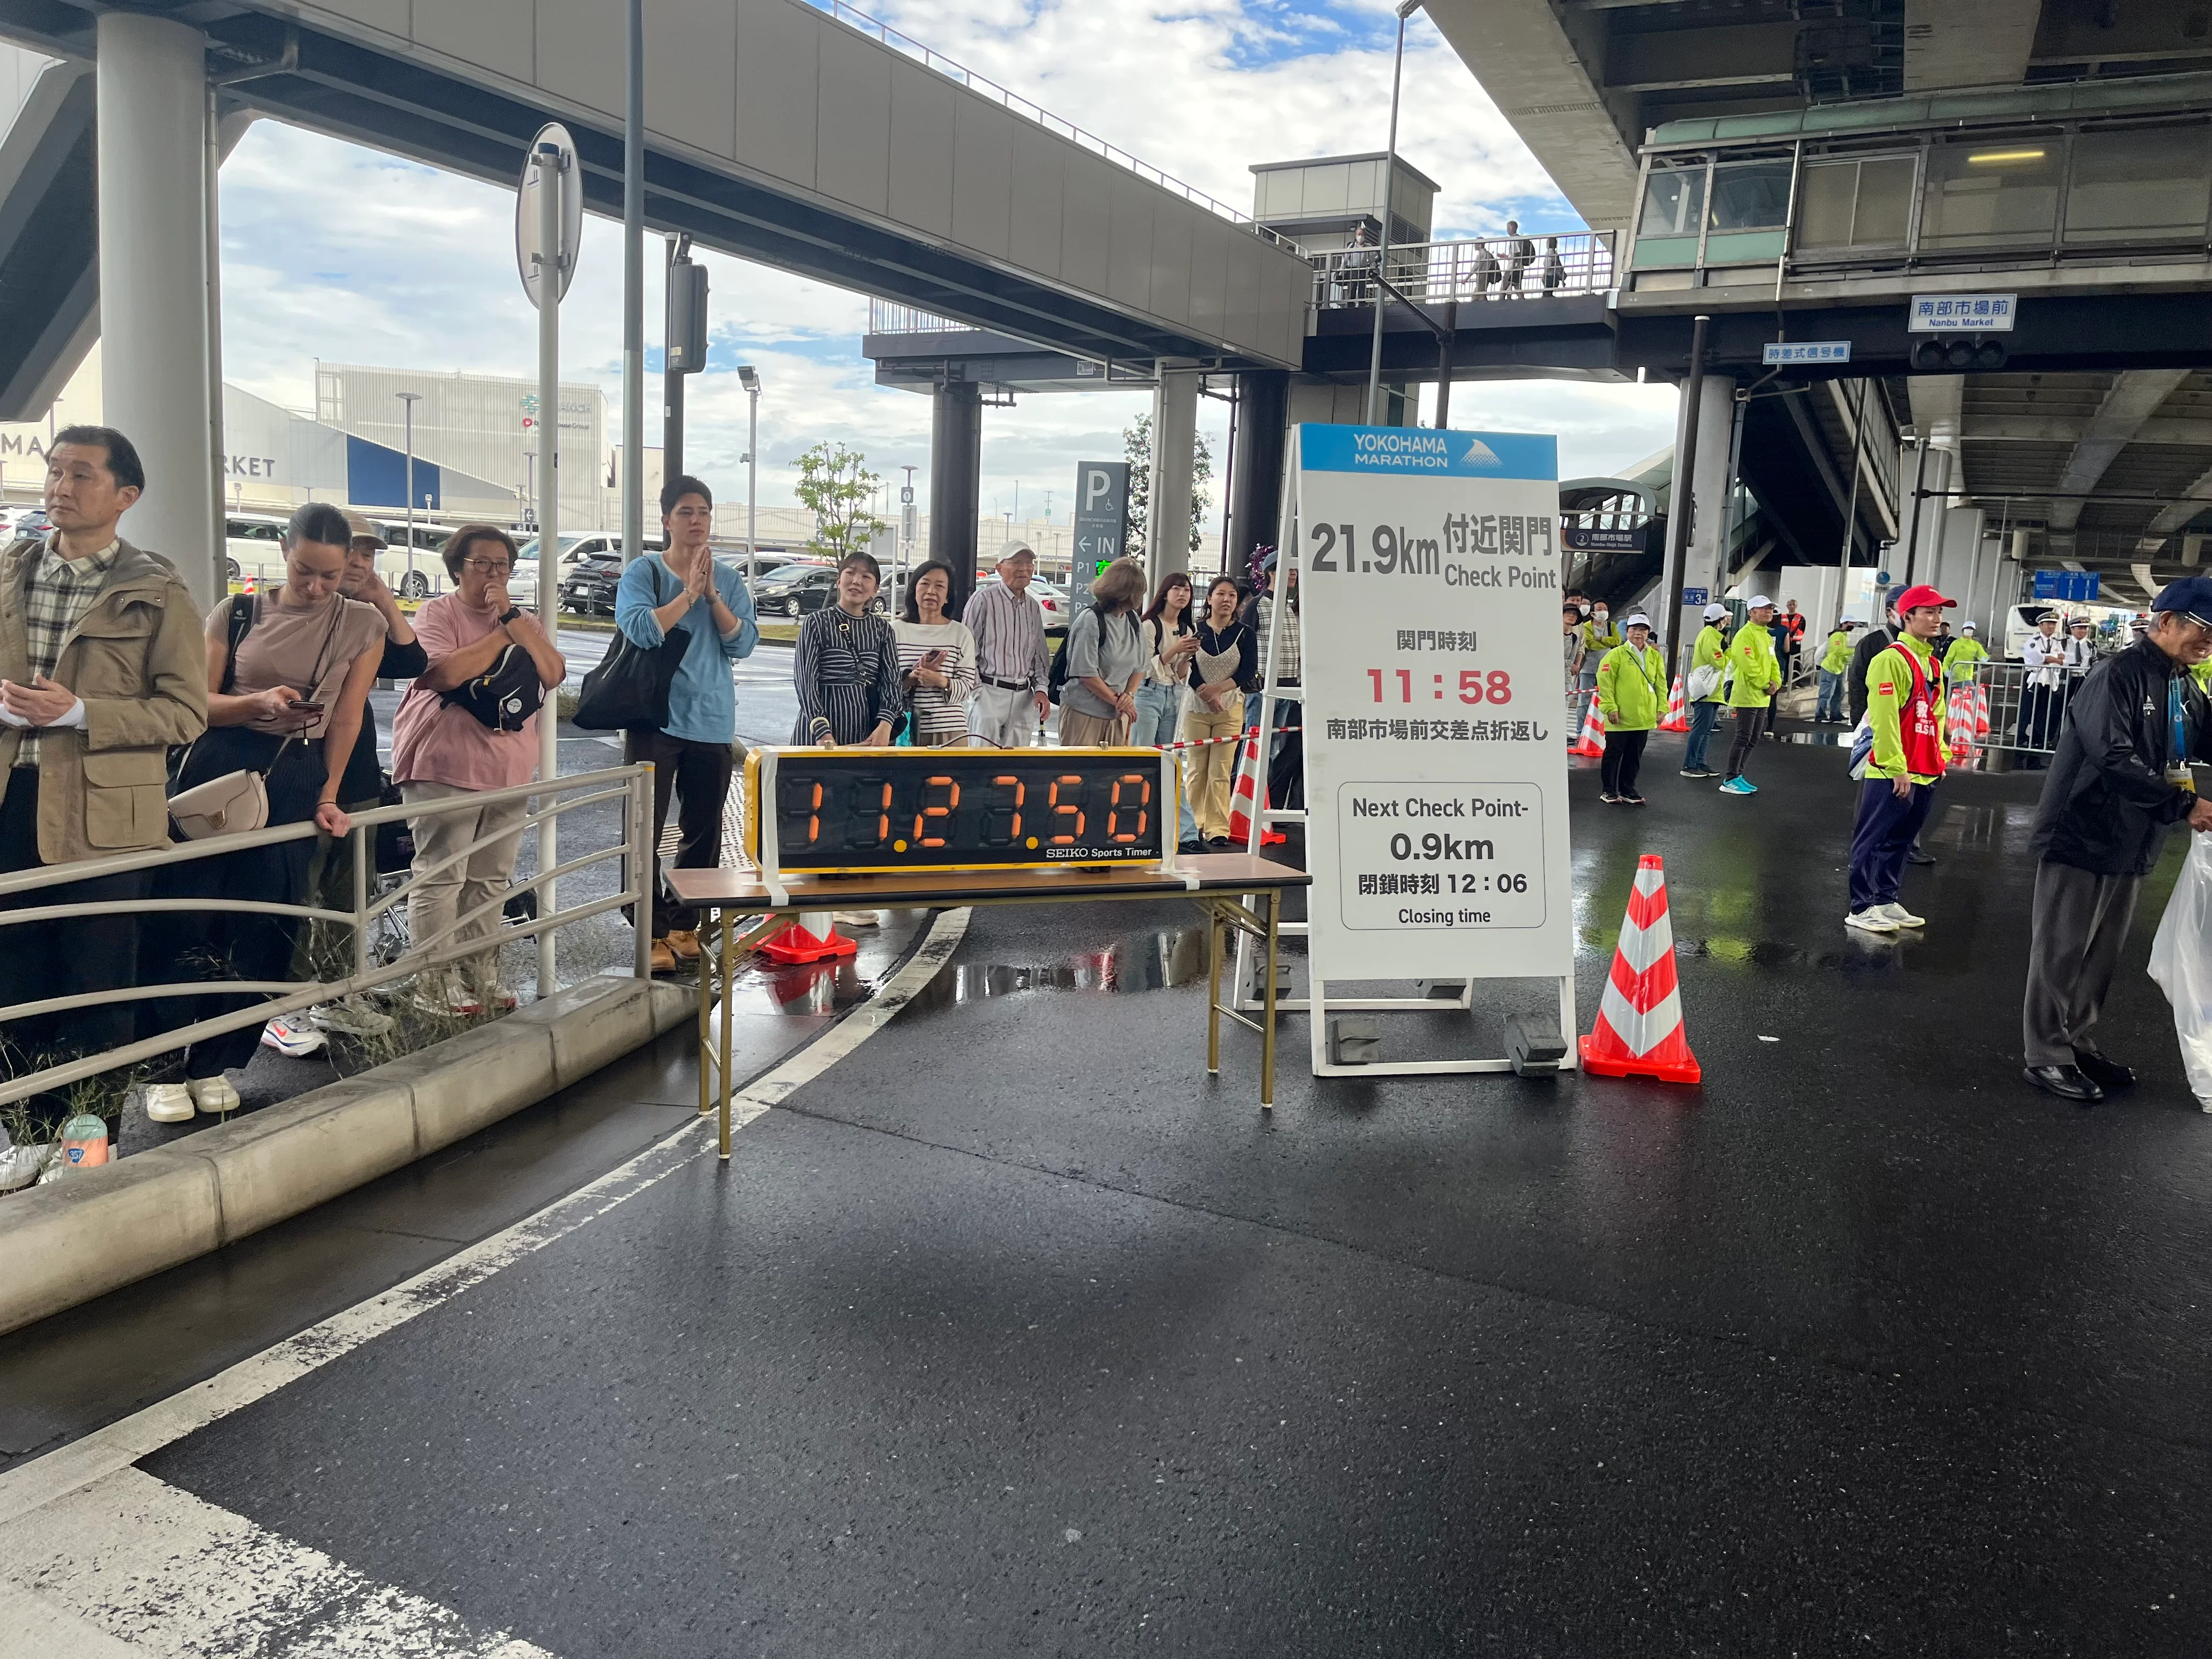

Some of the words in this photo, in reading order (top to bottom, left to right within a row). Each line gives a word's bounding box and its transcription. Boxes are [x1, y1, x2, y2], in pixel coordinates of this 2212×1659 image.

[1918, 300, 2008, 315] 南部市場前
[1769, 347, 1844, 359] 時差式信号機
[1353, 433, 1447, 454] YOKOHAMA
[1355, 455, 1448, 468] MARATHON
[1086, 470, 1111, 511] P
[1443, 512, 1552, 556] 付近関門
[1097, 537, 1115, 554] IN
[1311, 523, 1440, 575] 21.9km
[1077, 561, 1090, 574] P1
[1444, 564, 1503, 588] Check
[1509, 566, 1556, 589] Point
[1076, 582, 1089, 595] P2
[1397, 630, 1477, 651] 関門時刻
[1327, 719, 1548, 741] 南部市場前交差点折返し
[1353, 798, 1398, 817] Next
[1405, 798, 1465, 817] Check
[1471, 798, 1528, 817] Point-
[1046, 848, 1088, 858] SEIKO
[1091, 849, 1122, 858] Sports
[1125, 848, 1152, 856] Timer
[1390, 833, 1494, 860] 0.9km
[1358, 874, 1440, 895] 閉鎖時刻
[1398, 909, 1454, 927] Closing
[1458, 909, 1491, 923] time
[70, 1150, 83, 1160] 357
